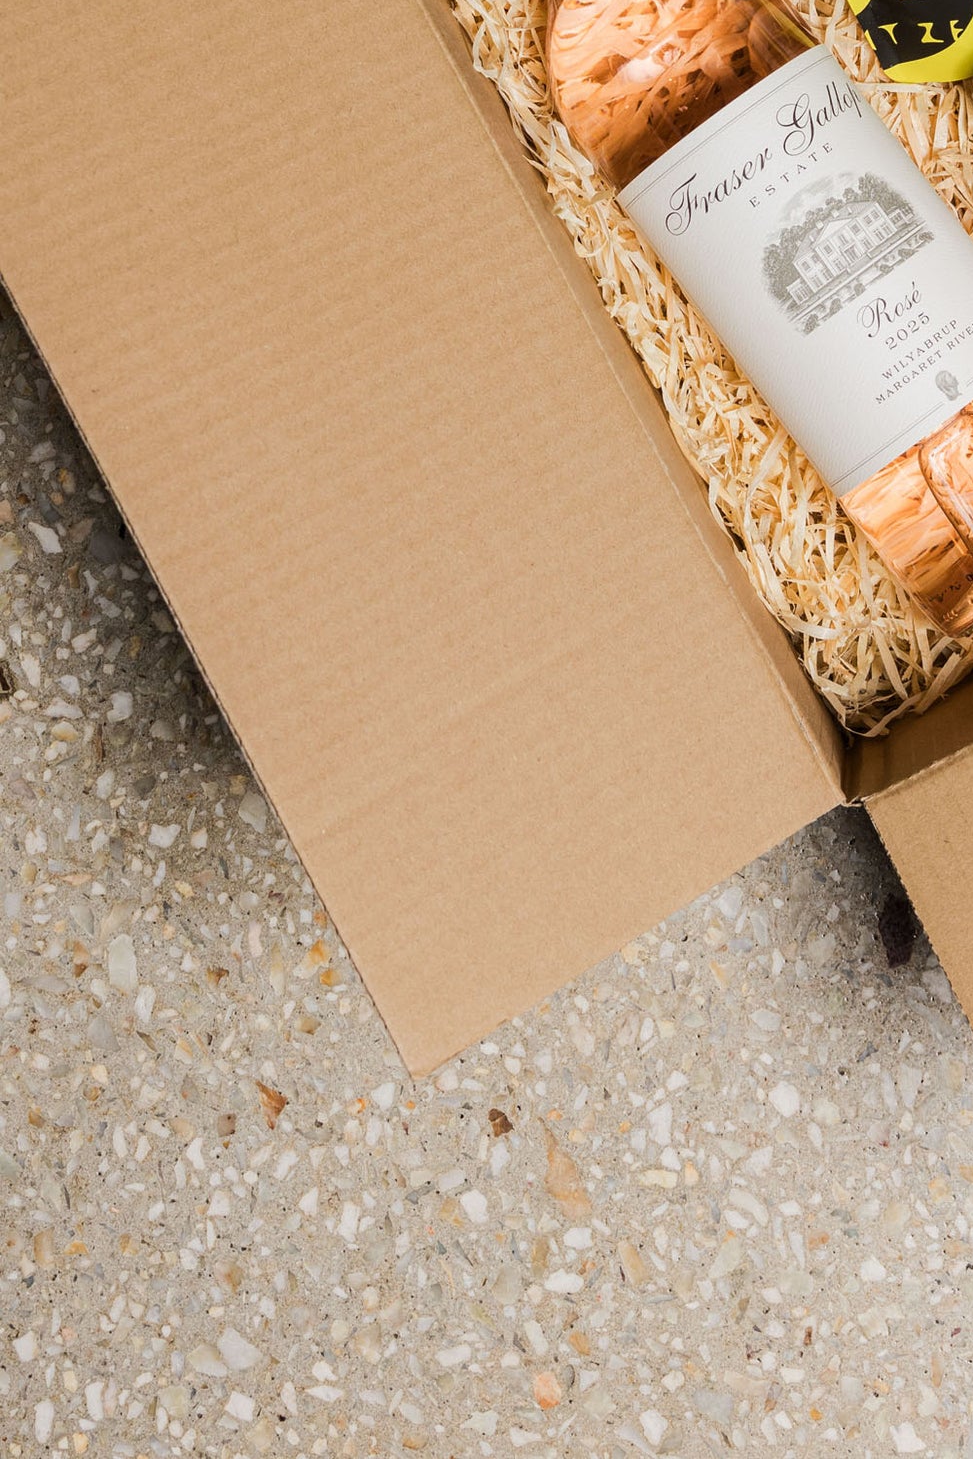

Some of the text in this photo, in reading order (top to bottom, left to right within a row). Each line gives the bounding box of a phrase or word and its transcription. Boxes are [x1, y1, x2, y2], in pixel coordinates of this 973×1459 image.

[665, 147, 772, 236] Fraser
[749, 142, 833, 208] ESTATE
[857, 281, 922, 338] Rosé
[885, 311, 930, 350] 2025
[875, 350, 942, 404] MARGARET
[882, 319, 958, 380] WILYABRUP
